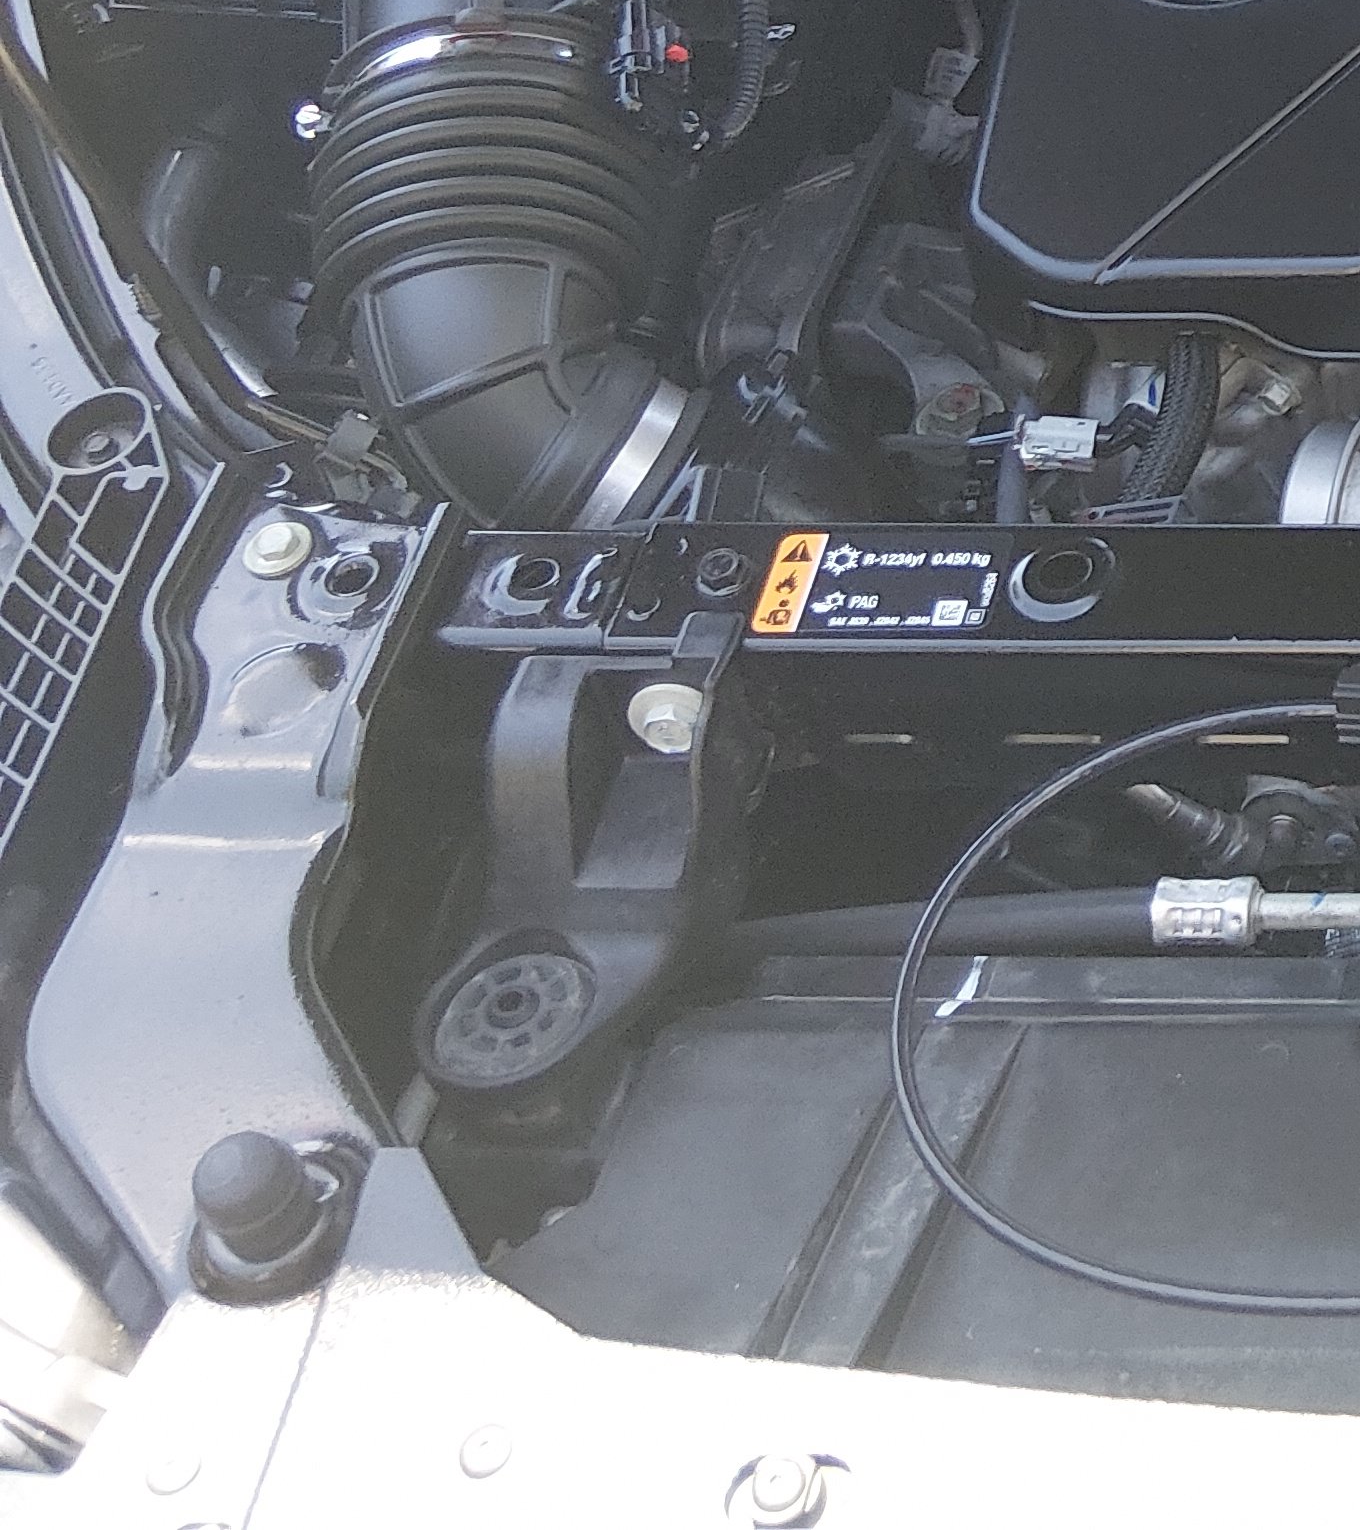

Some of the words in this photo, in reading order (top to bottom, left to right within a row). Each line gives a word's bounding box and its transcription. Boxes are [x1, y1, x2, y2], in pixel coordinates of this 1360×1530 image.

[930, 552, 972, 567] 0.450
[970, 552, 993, 568] kg
[847, 594, 880, 609] PAG
